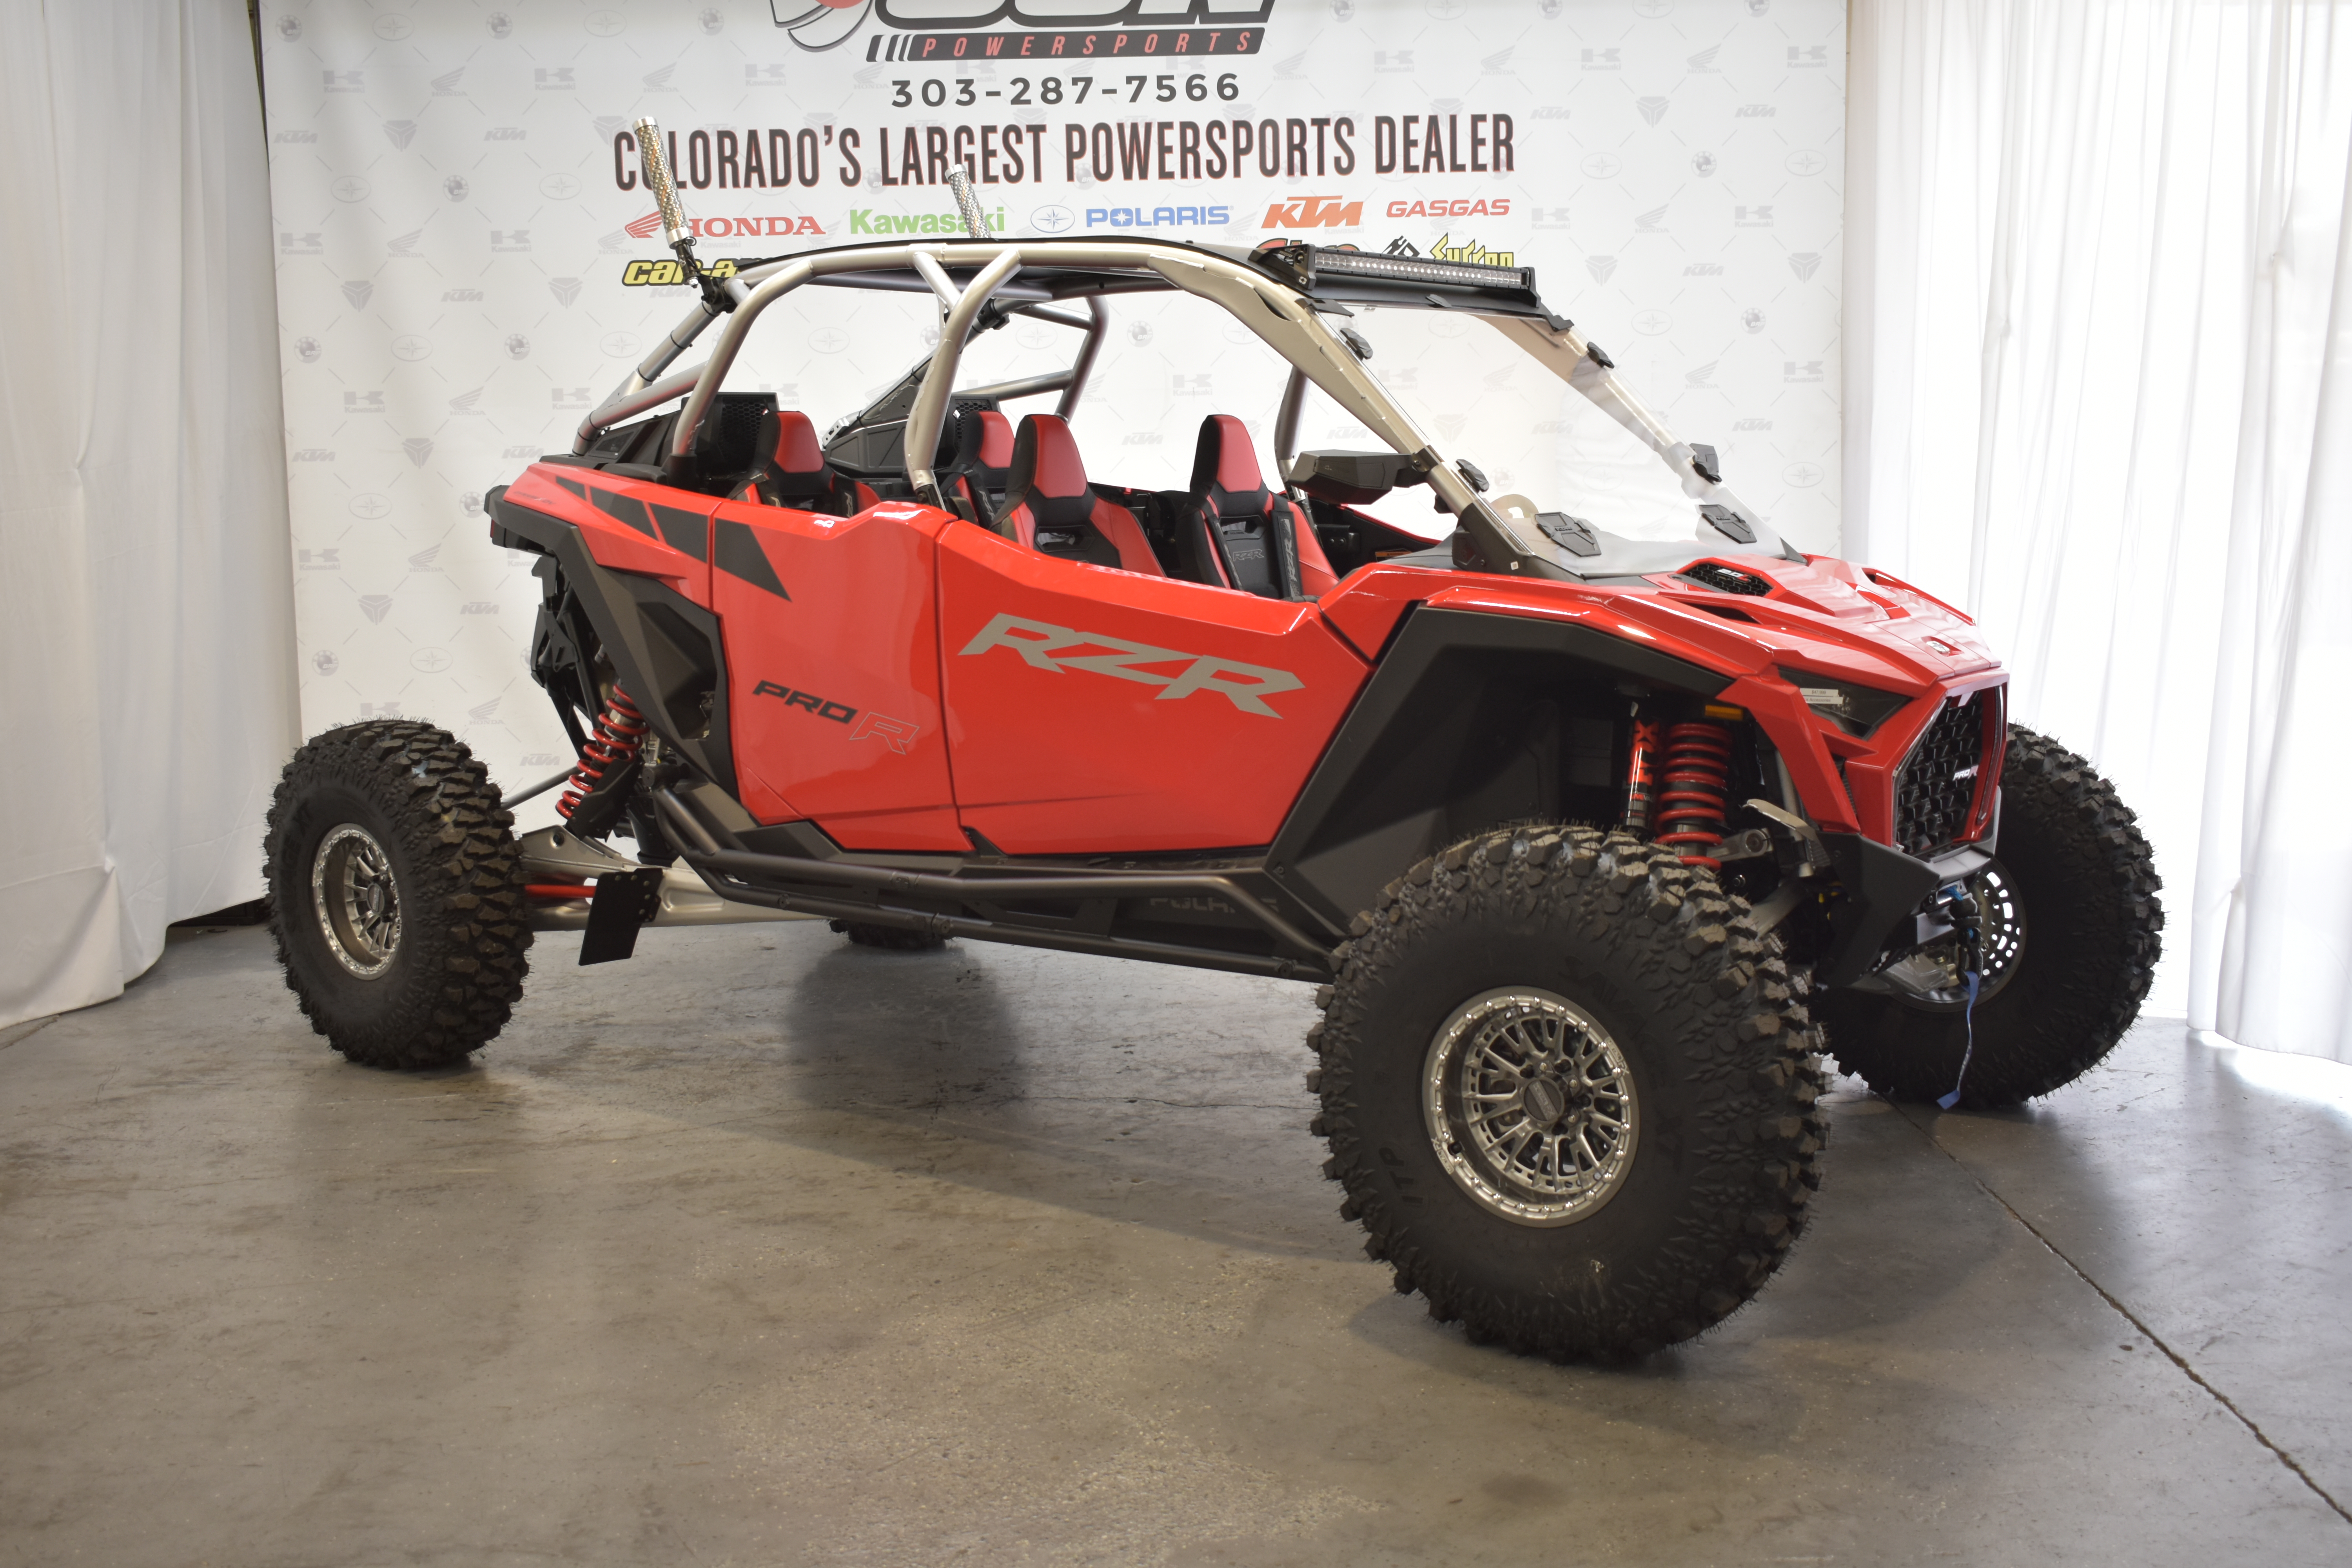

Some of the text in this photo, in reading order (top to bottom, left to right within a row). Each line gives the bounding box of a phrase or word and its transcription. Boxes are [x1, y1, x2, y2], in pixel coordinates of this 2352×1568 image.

[923, 32, 1250, 56] POWERSPORTS
[892, 73, 1239, 107] 303-287-7566
[1530, 106, 1571, 120] KTM
[1735, 104, 1776, 118] KTM
[274, 130, 318, 144] KTM
[483, 127, 526, 141] KTM
[614, 114, 1514, 191] CLORADO'S LARGEST POWERSPORTS DEALER
[1261, 196, 1364, 229] KTM
[1387, 199, 1511, 218] GASGAS
[1086, 206, 1229, 227] POLARIS
[1682, 263, 1724, 276] KTM
[441, 289, 484, 302] KTM
[1732, 418, 1773, 432] KTM
[1122, 432, 1163, 445] KTM
[1327, 426, 1367, 439] KTM
[291, 449, 336, 463] KTM
[501, 445, 543, 459] KTM
[1232, 548, 1265, 562] RZR
[460, 602, 499, 615] KTM
[957, 612, 1306, 719] RZR
[752, 680, 920, 755] PRO R
[519, 753, 560, 766] KTM
[1628, 720, 1659, 786] FOX
[1953, 769, 1970, 781] PRO
[1379, 1145, 1424, 1207] ITP
